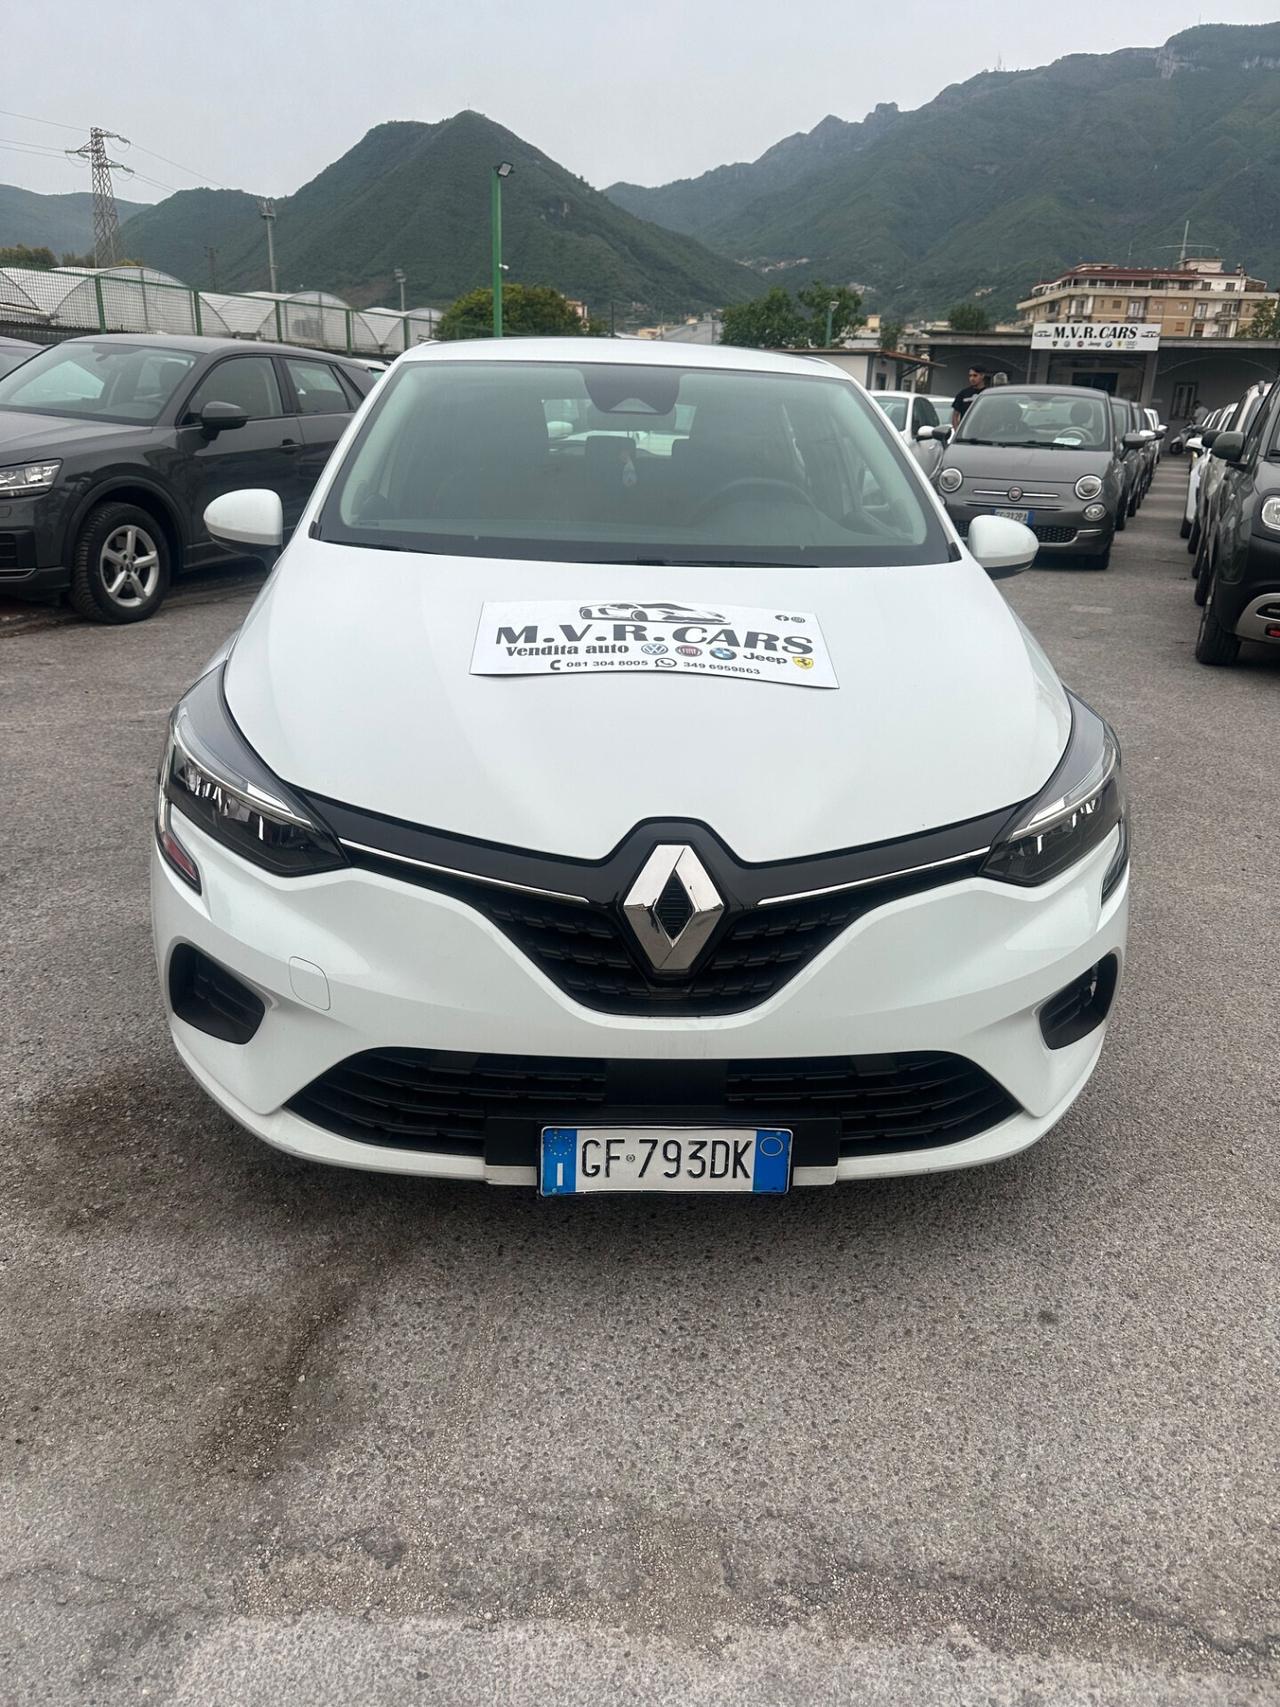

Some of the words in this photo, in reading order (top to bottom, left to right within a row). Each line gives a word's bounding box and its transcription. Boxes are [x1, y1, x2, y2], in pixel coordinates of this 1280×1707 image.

[506, 643, 579, 657] Vendita
[585, 643, 629, 655] auto
[566, 660, 587, 668] 081
[618, 659, 649, 667] 8005
[743, 652, 788, 665] Jeep
[683, 661, 706, 670] 349
[709, 663, 761, 675] 6959863
[581, 1139, 626, 1178] GF
[638, 1138, 753, 1179] 793DK
